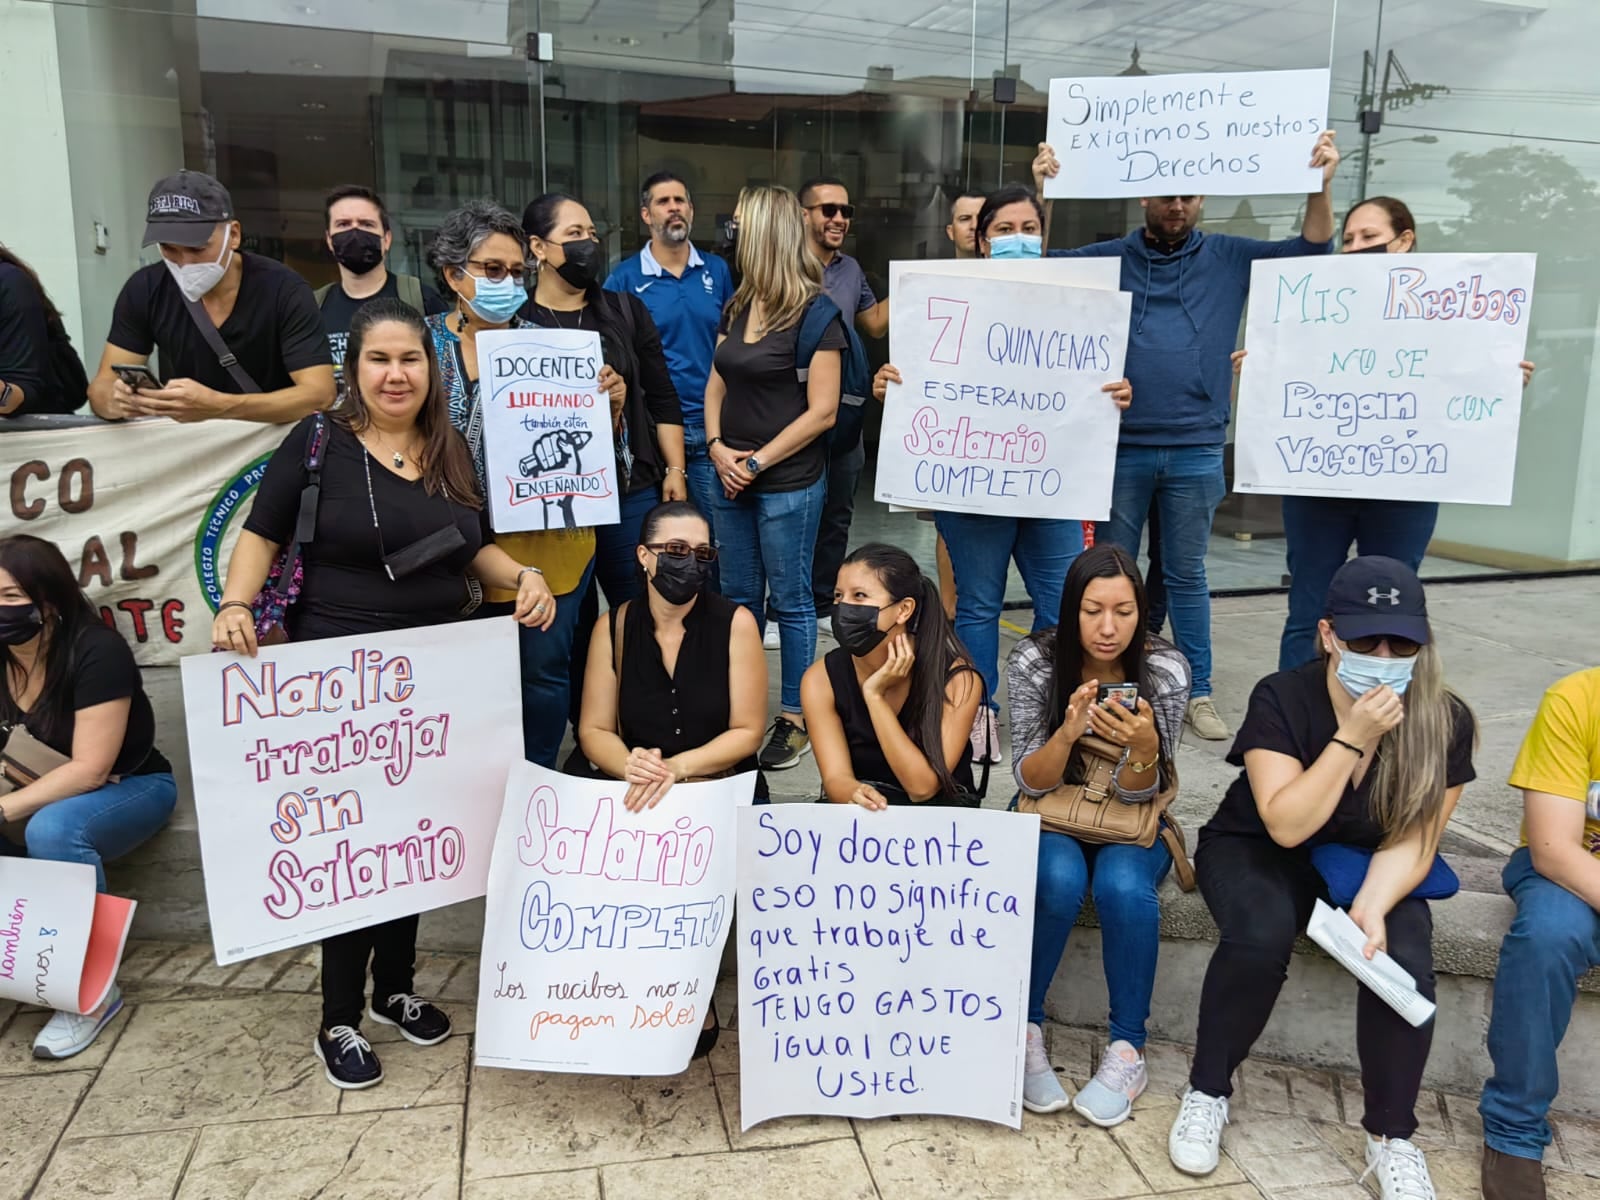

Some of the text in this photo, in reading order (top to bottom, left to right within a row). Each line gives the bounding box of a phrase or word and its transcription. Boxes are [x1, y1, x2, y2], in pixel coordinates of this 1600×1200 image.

[1062, 82, 1257, 126] Simplemente
[1226, 115, 1320, 137] nuestros
[1120, 150, 1260, 183] Derechos
[172, 194, 201, 215] RICA
[1383, 267, 1526, 325] Recibos
[928, 297, 1110, 372] 7 QUINCENAS
[495, 356, 596, 379] DOCENTES
[1328, 349, 1428, 378] NO SE
[506, 391, 594, 408] LUCHANDO
[924, 381, 1066, 412] ESPERANDO
[1283, 381, 1503, 437] Pagan CON
[520, 411, 589, 432] también están
[903, 406, 1047, 464] Salario
[1275, 429, 1448, 477] Vocación
[516, 475, 600, 498] ENSEÑANDO
[915, 460, 1062, 497] COMPLETO
[202, 547, 221, 602] COLEGIO
[222, 649, 415, 727] Nadie
[245, 708, 450, 786] trabaja
[271, 786, 363, 844] sin
[517, 785, 714, 886] Salario
[758, 812, 990, 874] Soy docente
[263, 819, 466, 920] Salario
[520, 880, 725, 953] COMPLETO
[752, 878, 1020, 929] eso no significa
[750, 918, 996, 963] que trabaje de
[494, 961, 699, 1000] Los recibos no se
[754, 955, 855, 990] Gratis
[530, 1001, 696, 1040] pagan solos
[752, 988, 1002, 1027] TENGO GASTOS
[890, 1032, 951, 1057] QUE
